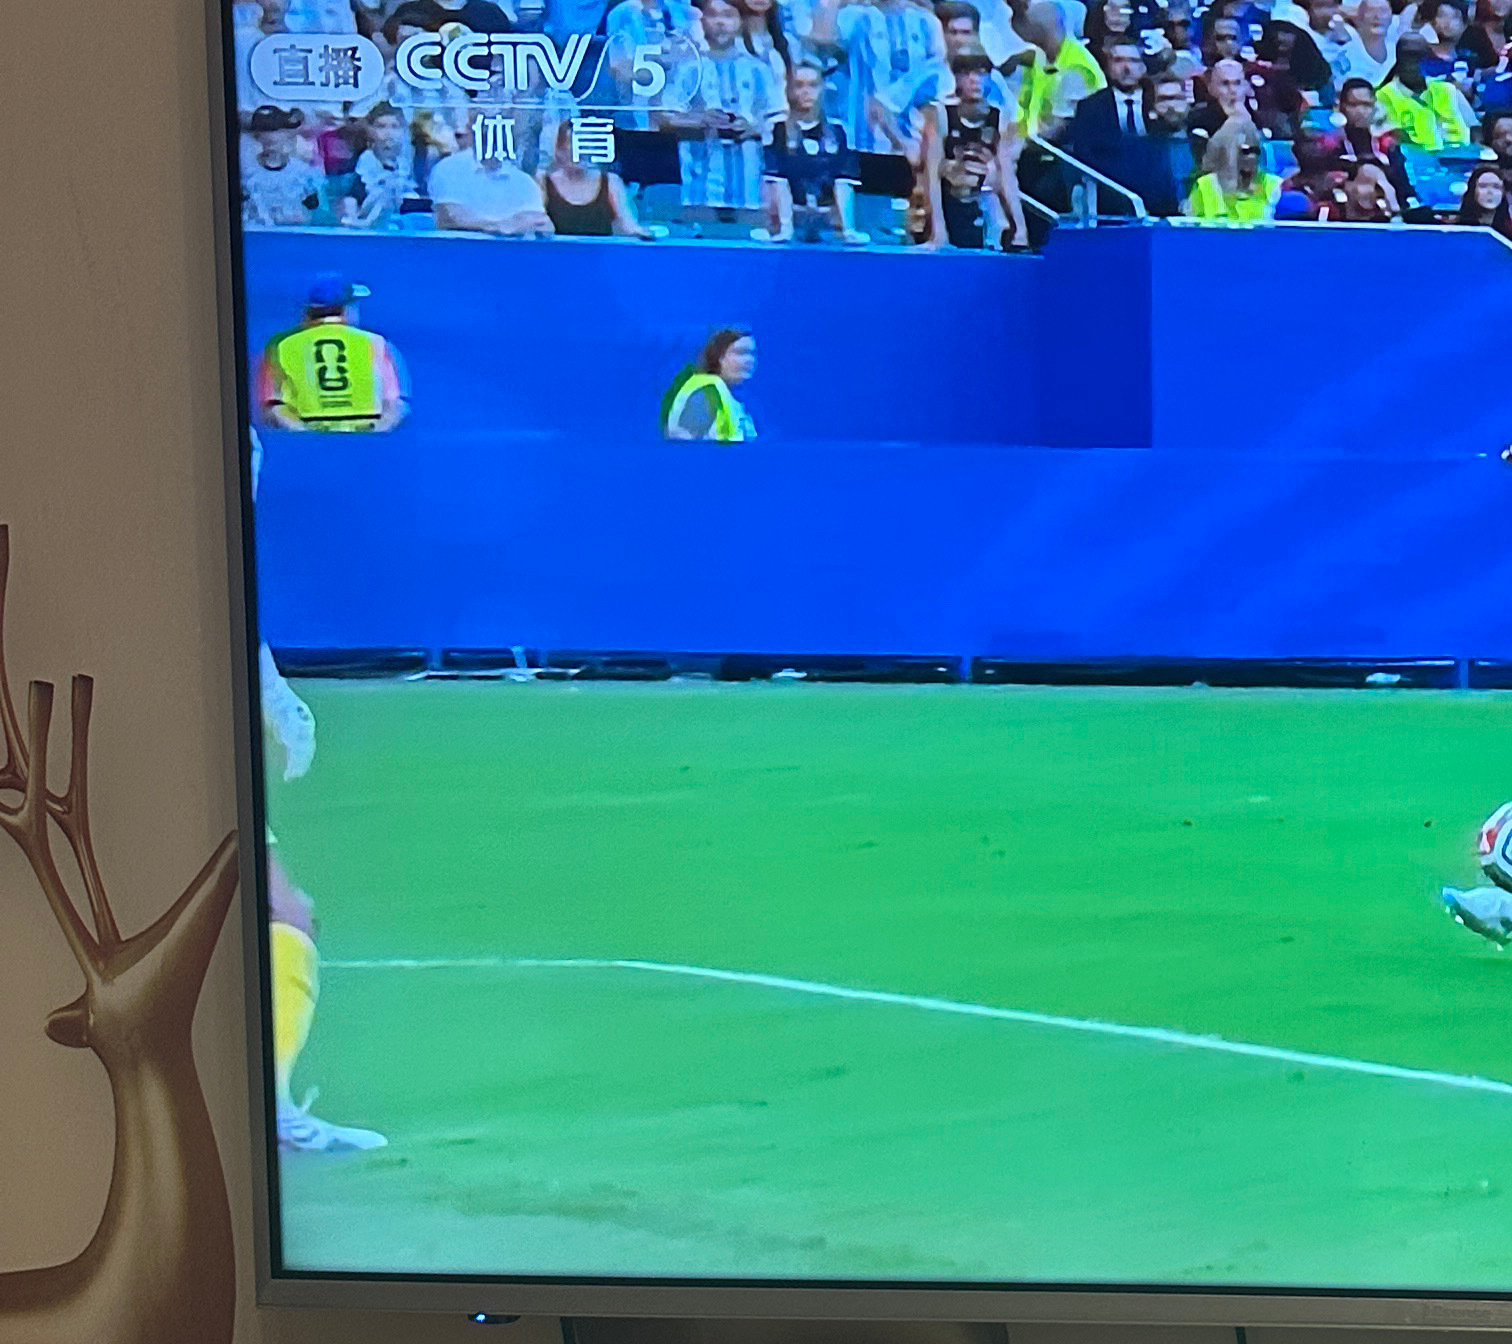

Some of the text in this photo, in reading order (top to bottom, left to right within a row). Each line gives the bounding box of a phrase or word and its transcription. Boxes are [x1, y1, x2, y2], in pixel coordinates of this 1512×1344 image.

[272, 44, 363, 89] 直播
[396, 32, 667, 98] CCTV 5
[471, 113, 617, 164] 体育
